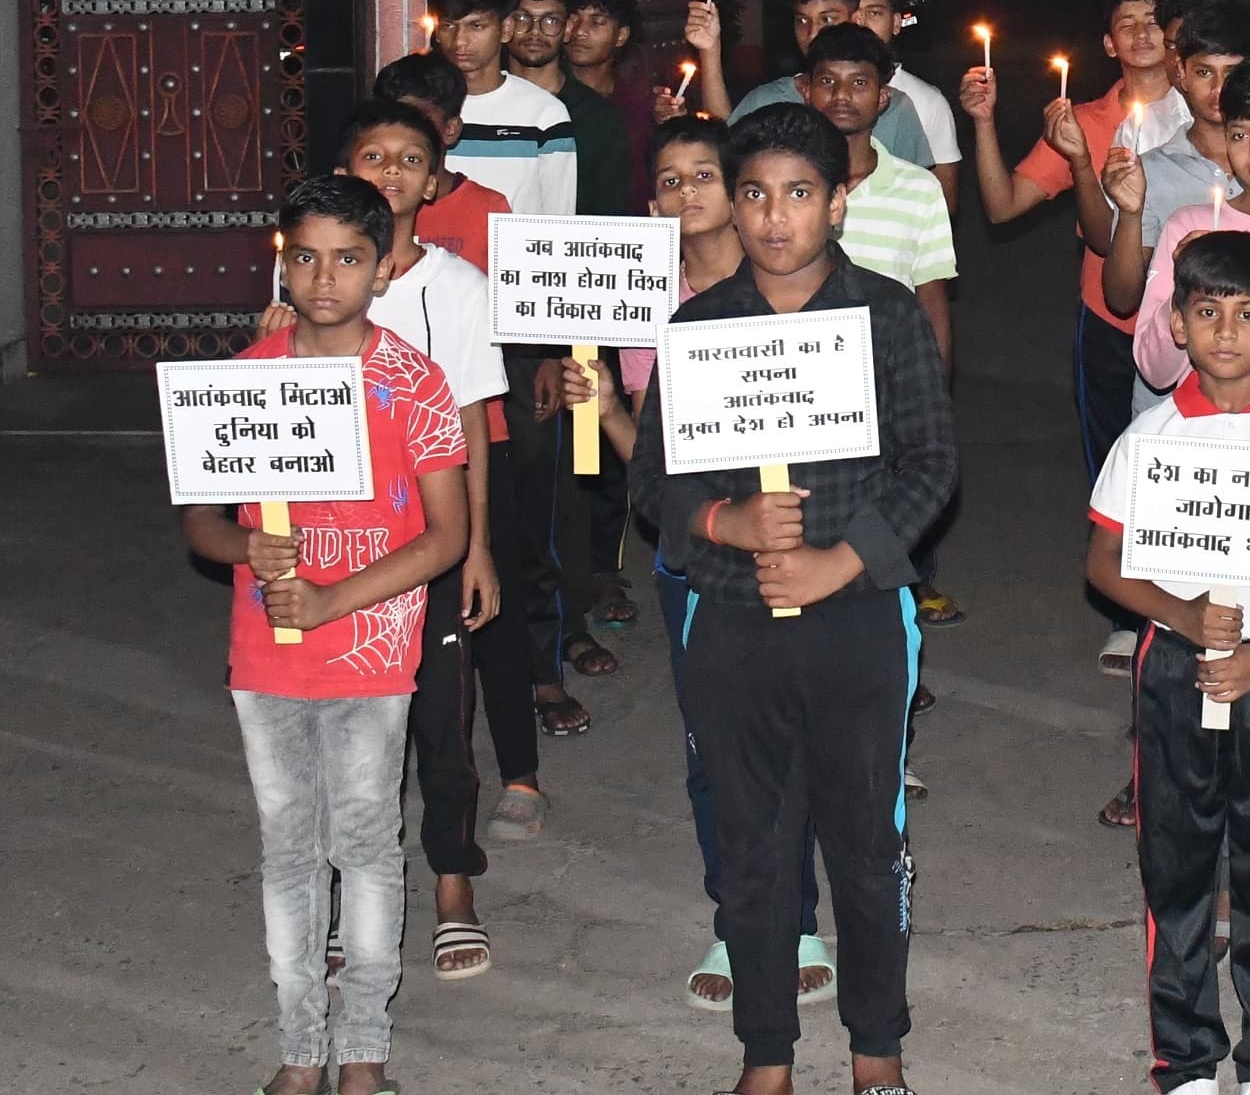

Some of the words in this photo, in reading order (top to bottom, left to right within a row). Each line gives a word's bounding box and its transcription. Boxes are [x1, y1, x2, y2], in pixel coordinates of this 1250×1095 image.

[525, 239, 553, 256] जब
[563, 237, 644, 263] आतंकवाद
[500, 269, 521, 286] का
[531, 270, 567, 288] नाश
[577, 266, 617, 290] होगा
[627, 268, 668, 292] विश्व
[515, 300, 537, 318] का
[546, 296, 602, 321] विकास
[612, 299, 652, 323] होगा
[688, 339, 785, 362] भारतवासी
[798, 341, 821, 354] का
[834, 334, 844, 352] है
[741, 367, 797, 383] सपना
[172, 384, 267, 410] आतंकवाद
[279, 380, 352, 406] मिटाओ
[723, 389, 815, 409] आतंकवाद
[213, 416, 279, 448] दुनिया
[291, 415, 316, 440] को
[678, 421, 721, 441] मुक्त
[733, 414, 764, 435] देश
[777, 411, 794, 429] हो
[808, 410, 864, 427] अपना
[202, 449, 257, 474] बेहतर
[269, 448, 335, 473] बनाओ
[1147, 457, 1181, 484] देश
[1193, 467, 1218, 485] का
[1175, 495, 1250, 521] जागेगा
[1135, 526, 1232, 556] आतंकवाद
